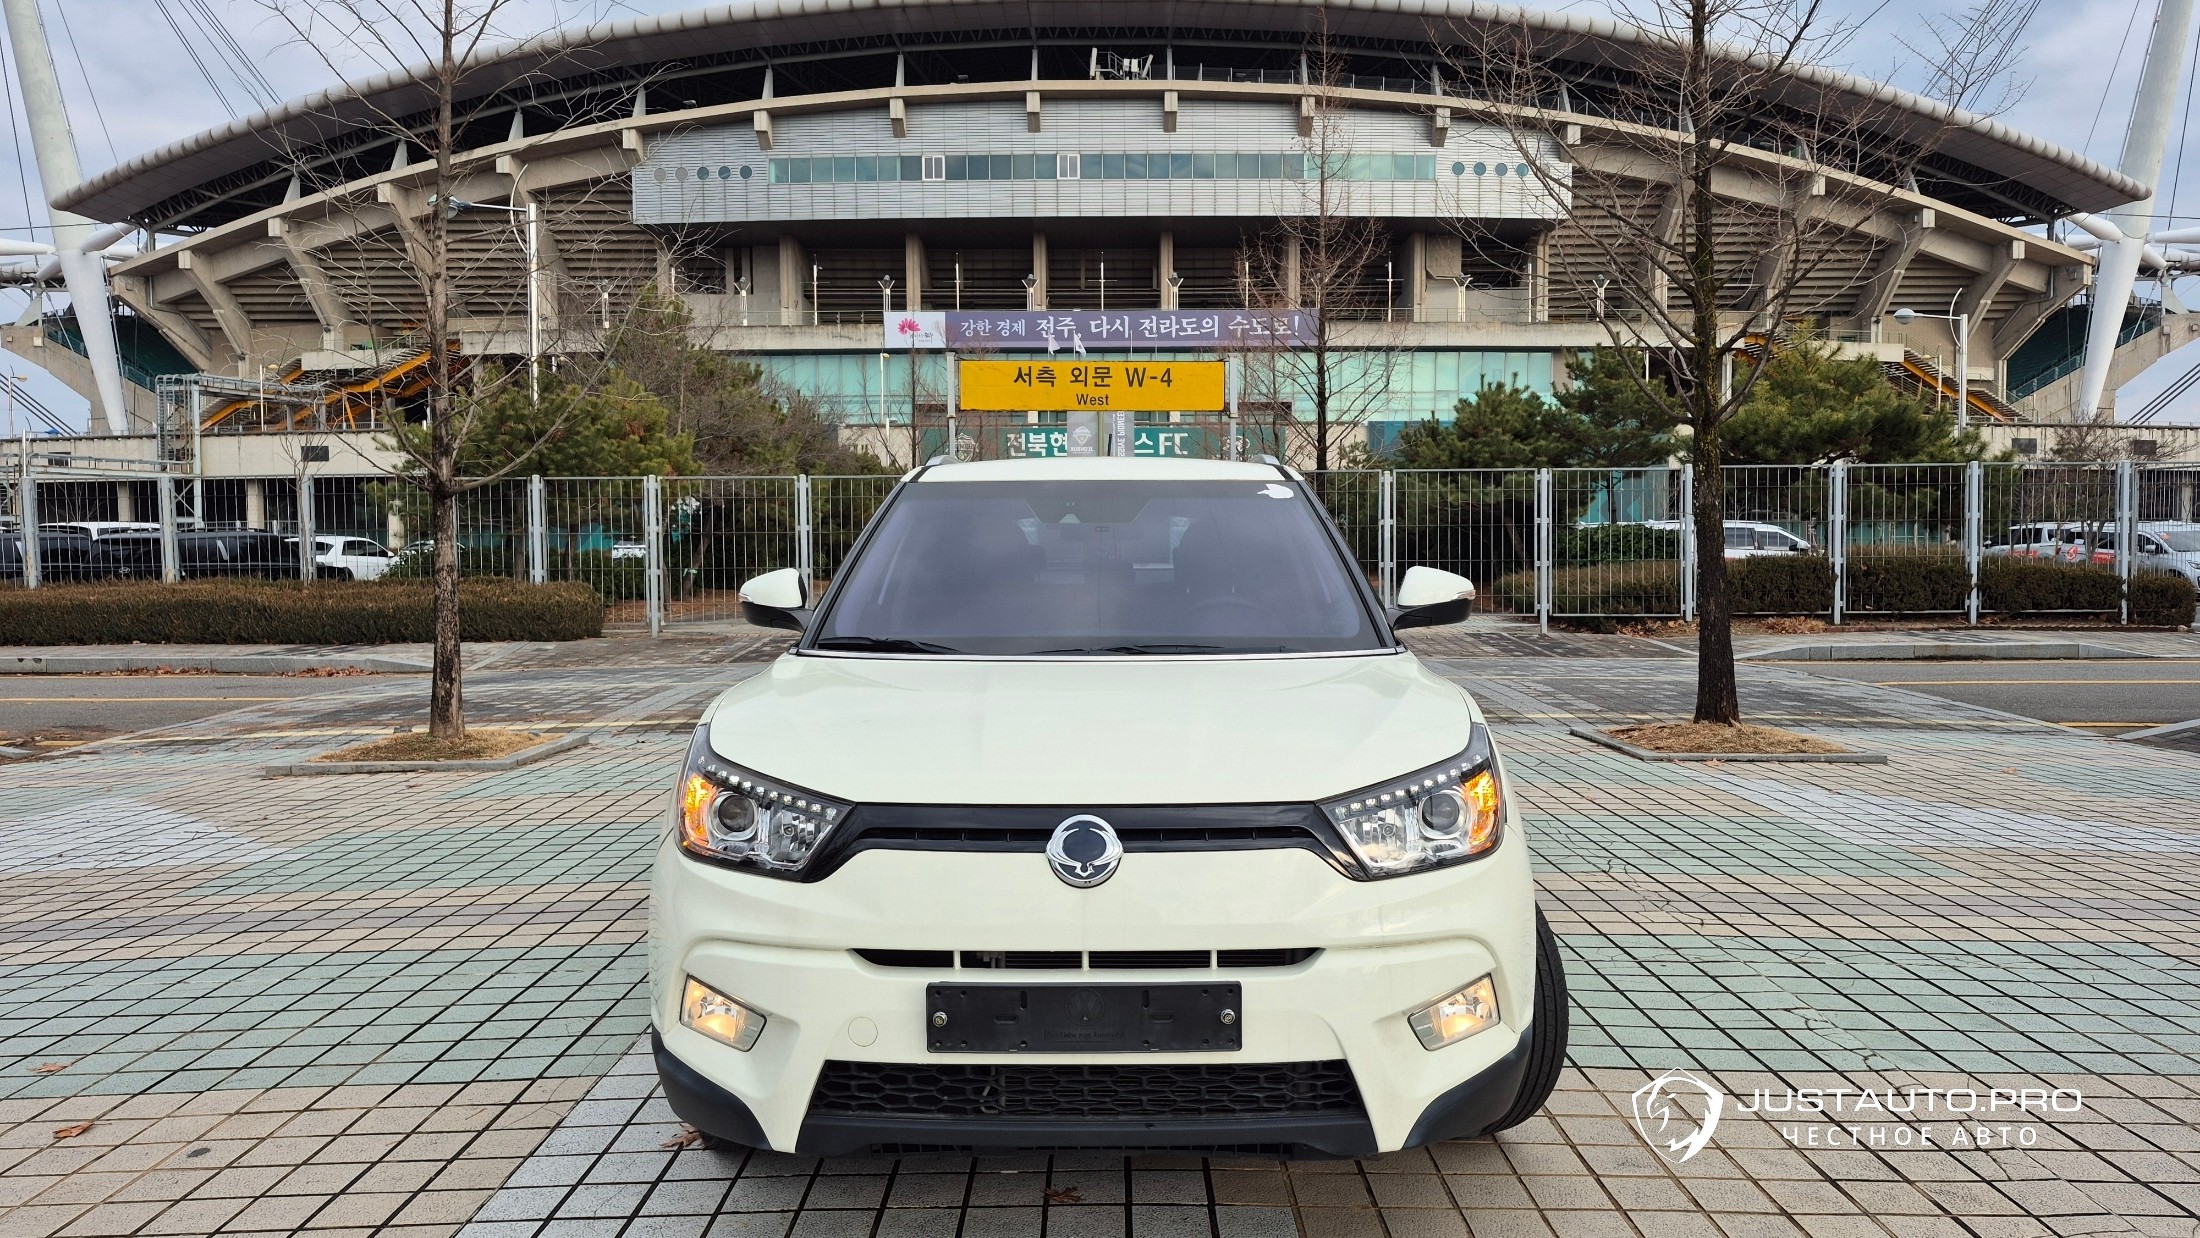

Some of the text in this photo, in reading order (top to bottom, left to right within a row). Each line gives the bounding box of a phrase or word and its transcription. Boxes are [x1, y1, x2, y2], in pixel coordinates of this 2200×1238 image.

[960, 318, 992, 337] 강한
[996, 318, 1026, 337] 경제
[1089, 315, 1129, 339] 다시
[1138, 315, 1219, 338] 전라도의
[1013, 365, 1173, 388] 서측 외문 W-4
[1075, 393, 1110, 406] West
